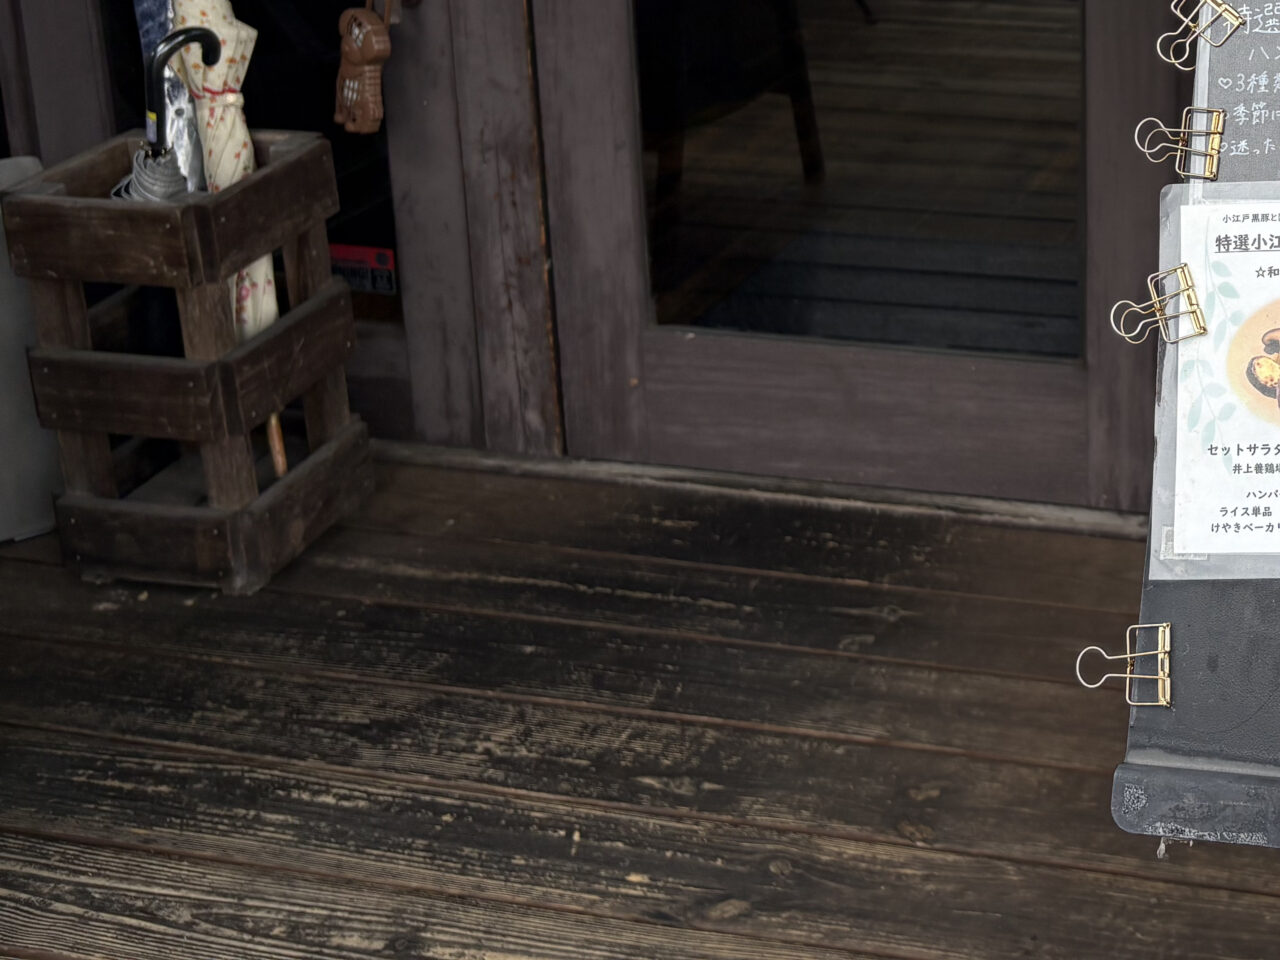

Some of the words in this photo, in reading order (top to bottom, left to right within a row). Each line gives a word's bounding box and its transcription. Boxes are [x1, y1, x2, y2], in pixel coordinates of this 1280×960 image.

[1219, 506, 1273, 518] ライス単品
